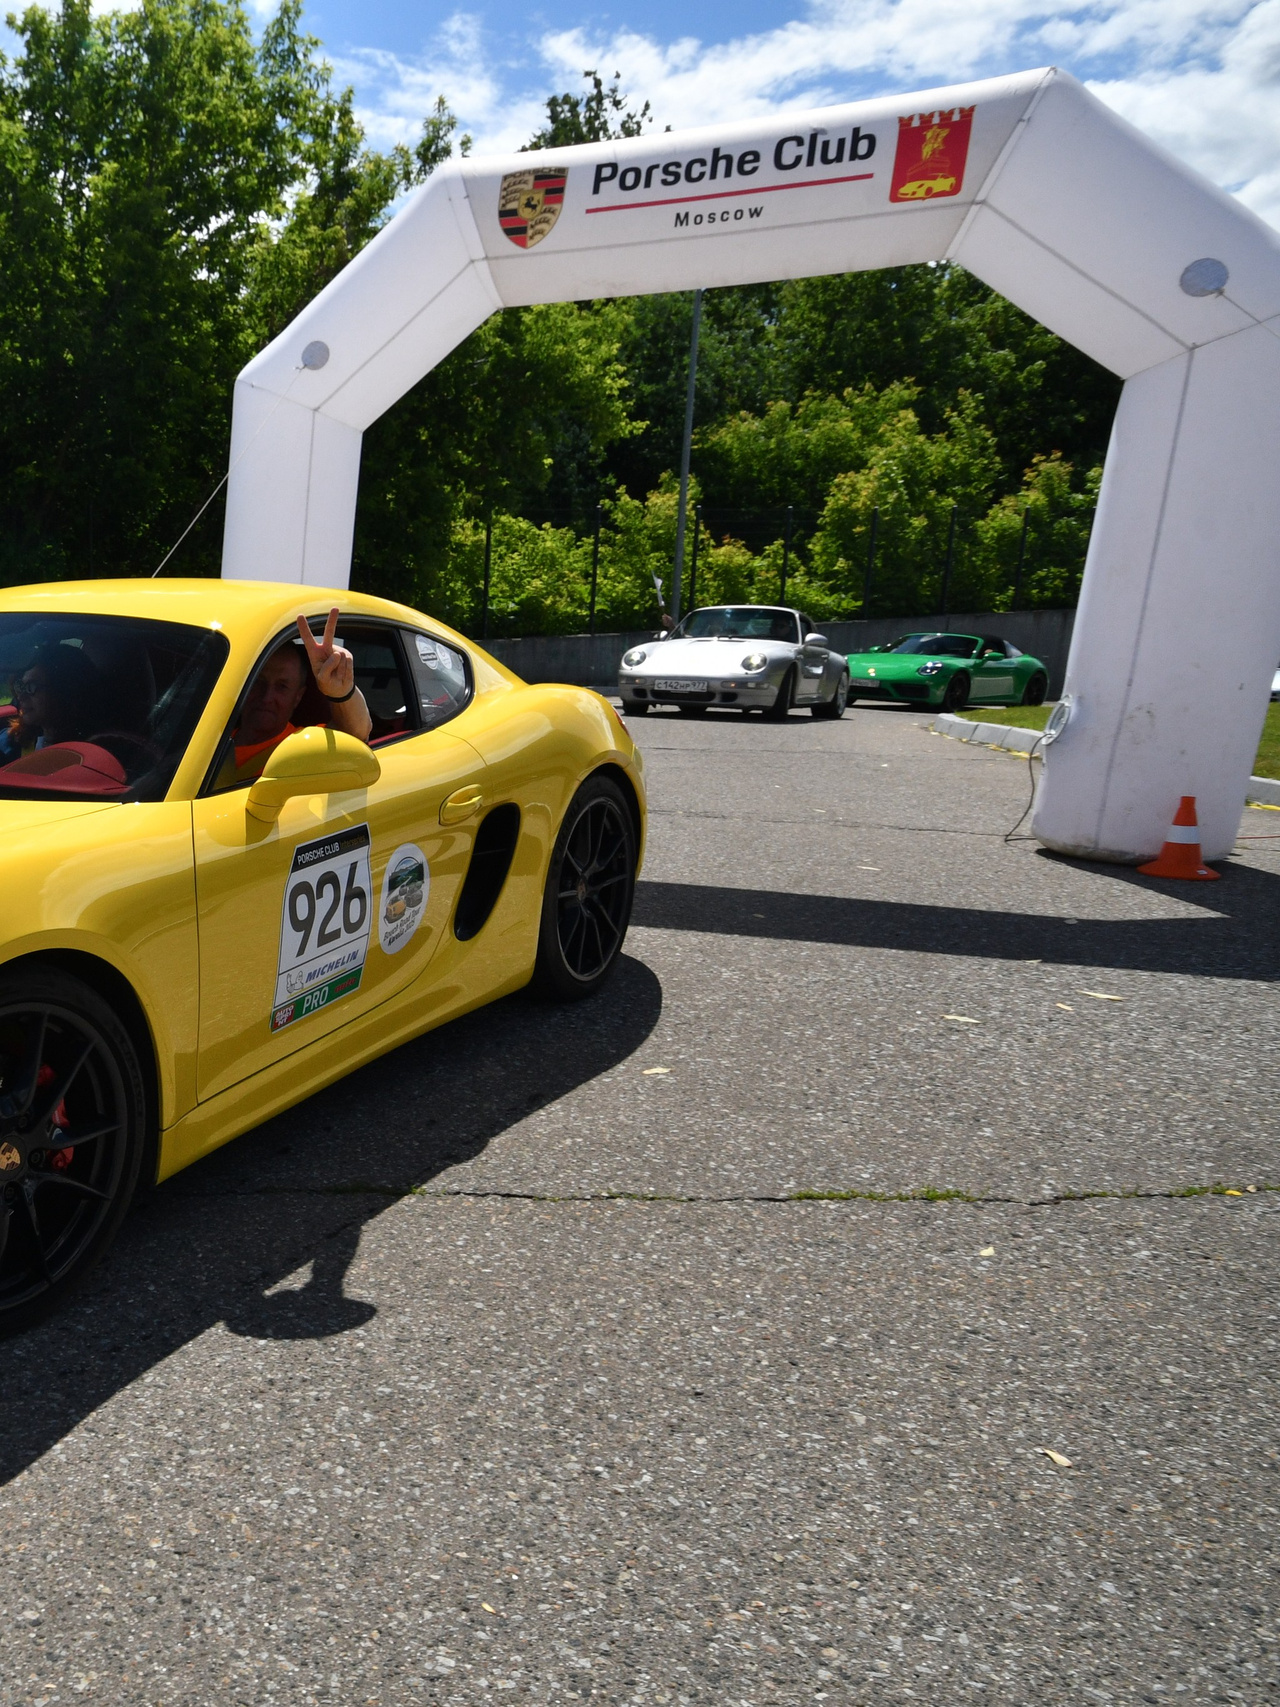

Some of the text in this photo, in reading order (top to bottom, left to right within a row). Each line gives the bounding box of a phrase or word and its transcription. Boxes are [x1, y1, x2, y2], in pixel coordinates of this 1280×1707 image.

[591, 126, 877, 195] Porsche Club
[673, 205, 764, 228] Moscow
[297, 847, 325, 866] PORSCHE
[324, 841, 340, 856] CLUB
[288, 861, 367, 958] 926
[305, 949, 360, 984] MICHELIN
[302, 986, 329, 1015] PRO
